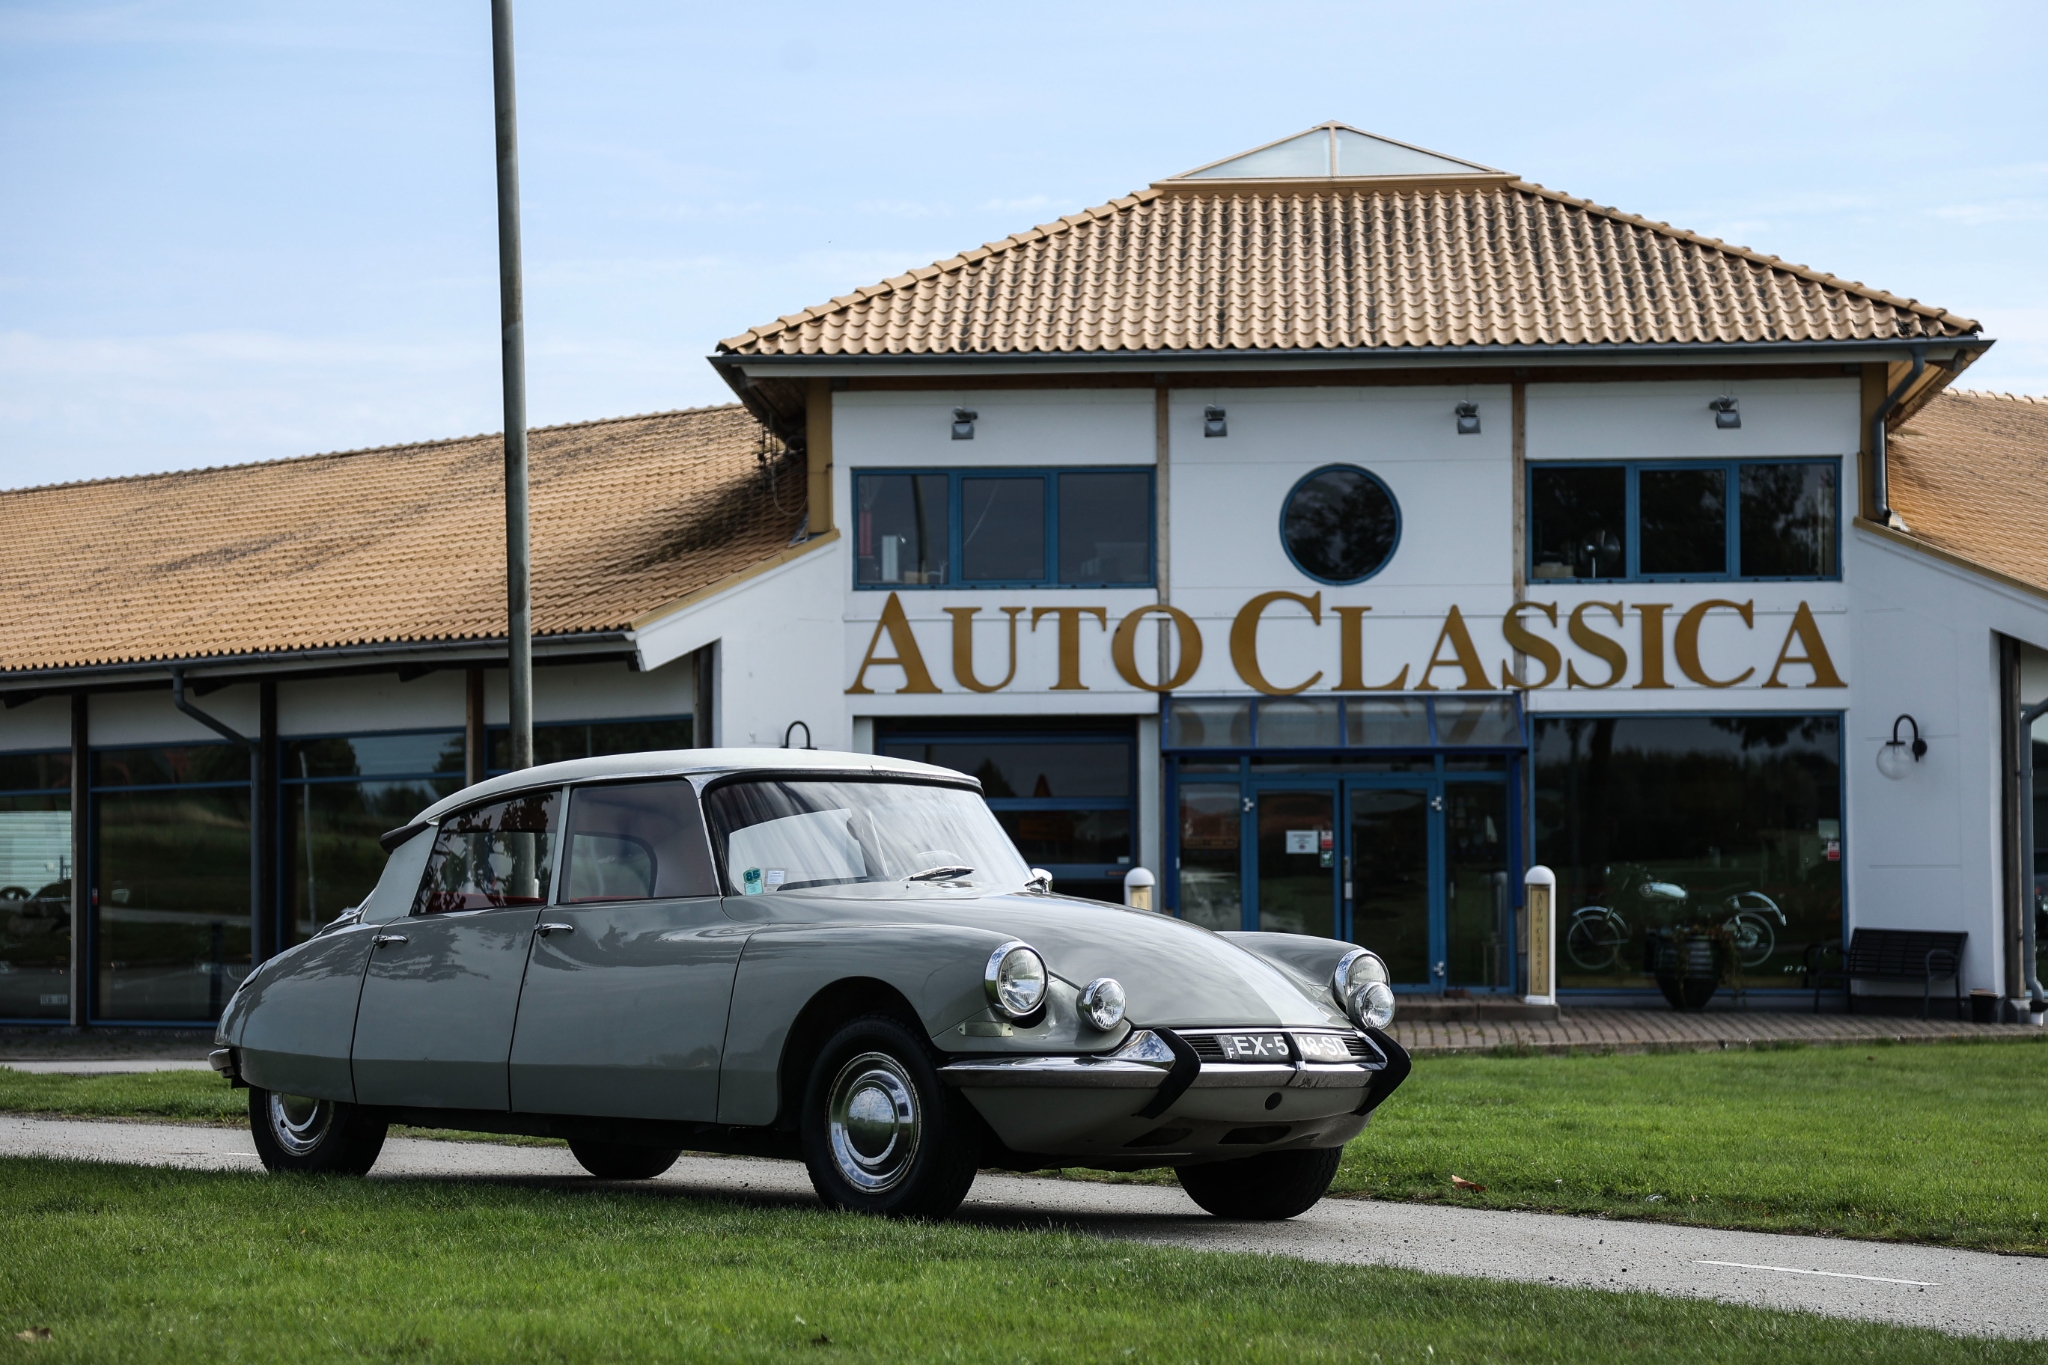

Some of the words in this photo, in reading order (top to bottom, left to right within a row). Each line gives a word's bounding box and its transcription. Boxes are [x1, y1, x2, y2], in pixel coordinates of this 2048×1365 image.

[844, 590, 1203, 694] AUTO
[1228, 590, 1848, 695] CLASSICA
[746, 870, 760, 881] 85
[1226, 1047, 1235, 1059] F
